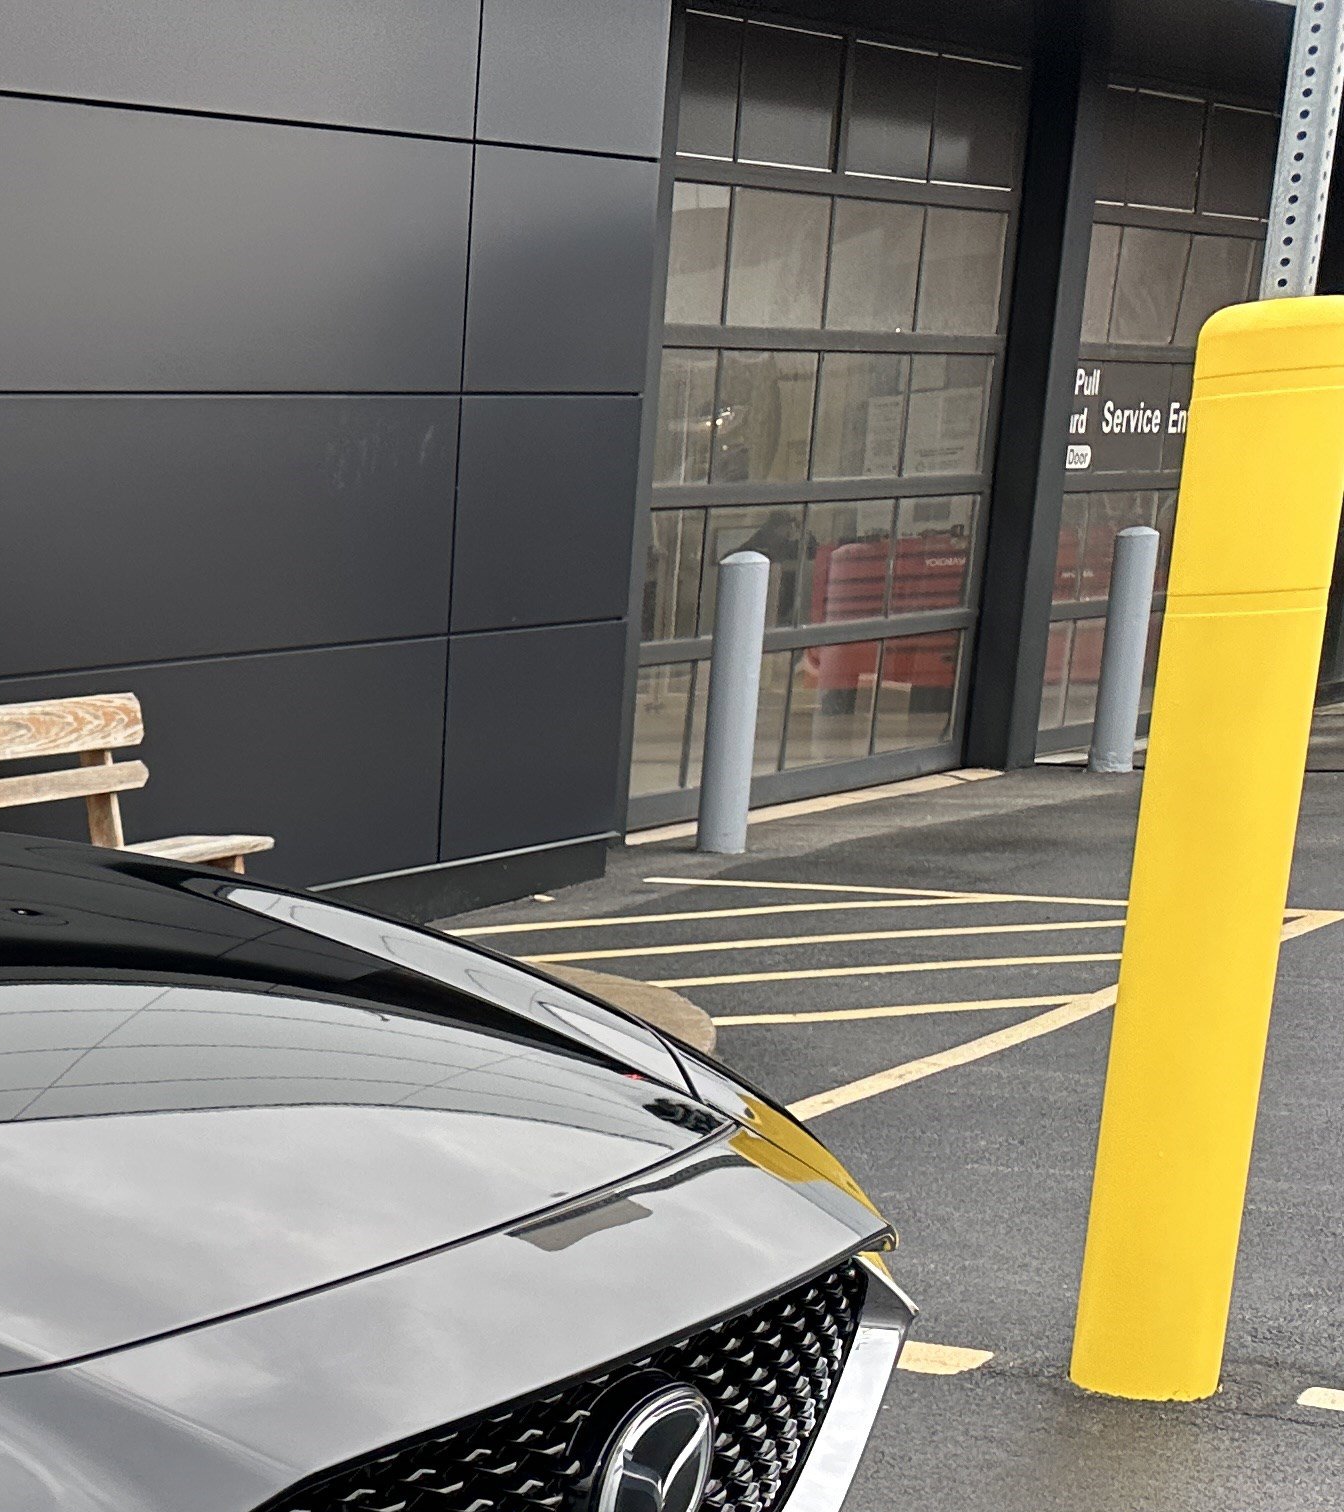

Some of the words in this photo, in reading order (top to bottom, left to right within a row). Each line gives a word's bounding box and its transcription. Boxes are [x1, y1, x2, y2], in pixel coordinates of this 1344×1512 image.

[1074, 368, 1101, 396] Pull
[1101, 400, 1161, 434] Service
[1167, 402, 1189, 434] En
[1068, 448, 1088, 465] Door
